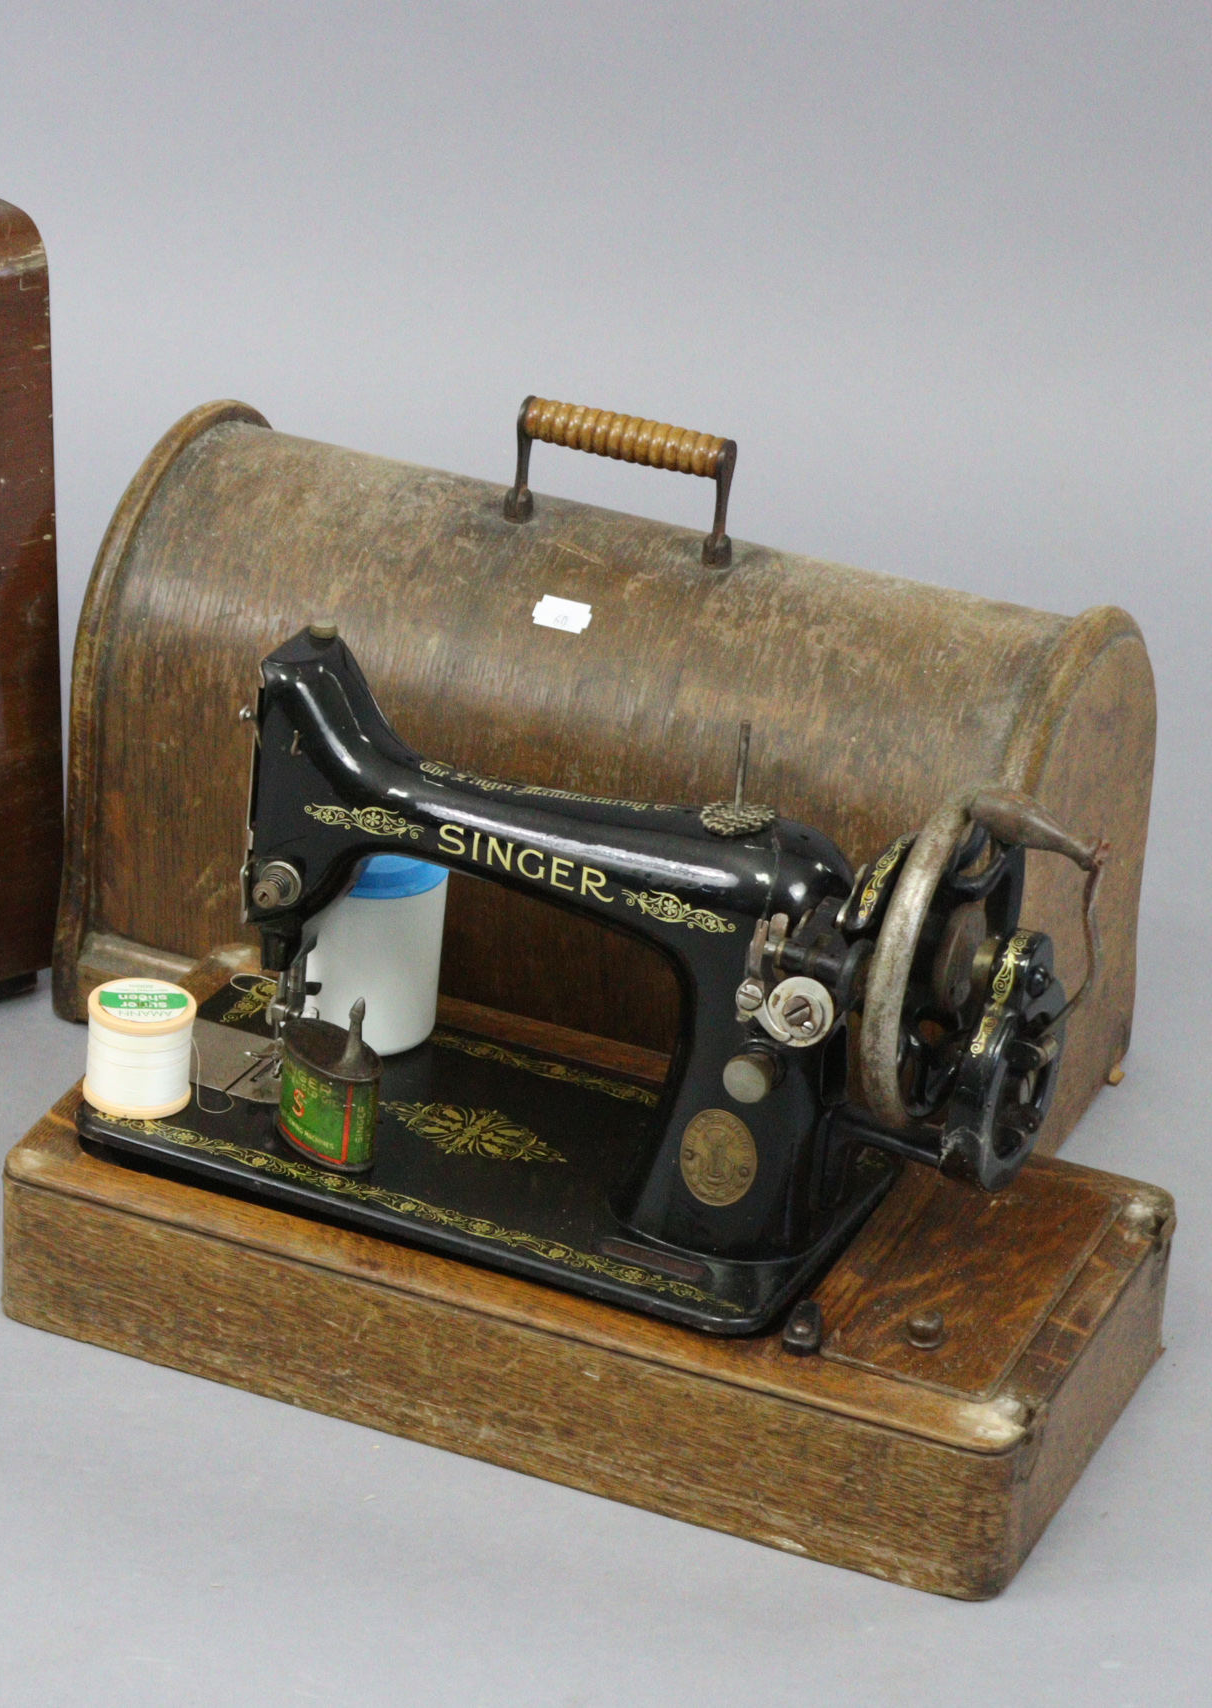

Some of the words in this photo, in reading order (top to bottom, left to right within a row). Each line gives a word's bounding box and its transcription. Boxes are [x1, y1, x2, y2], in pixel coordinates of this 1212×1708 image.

[438, 824, 614, 903] SINGER
[119, 1010, 172, 1018] AMANN
[292, 1088, 306, 1118] S
[354, 1106, 367, 1143] SINGER
